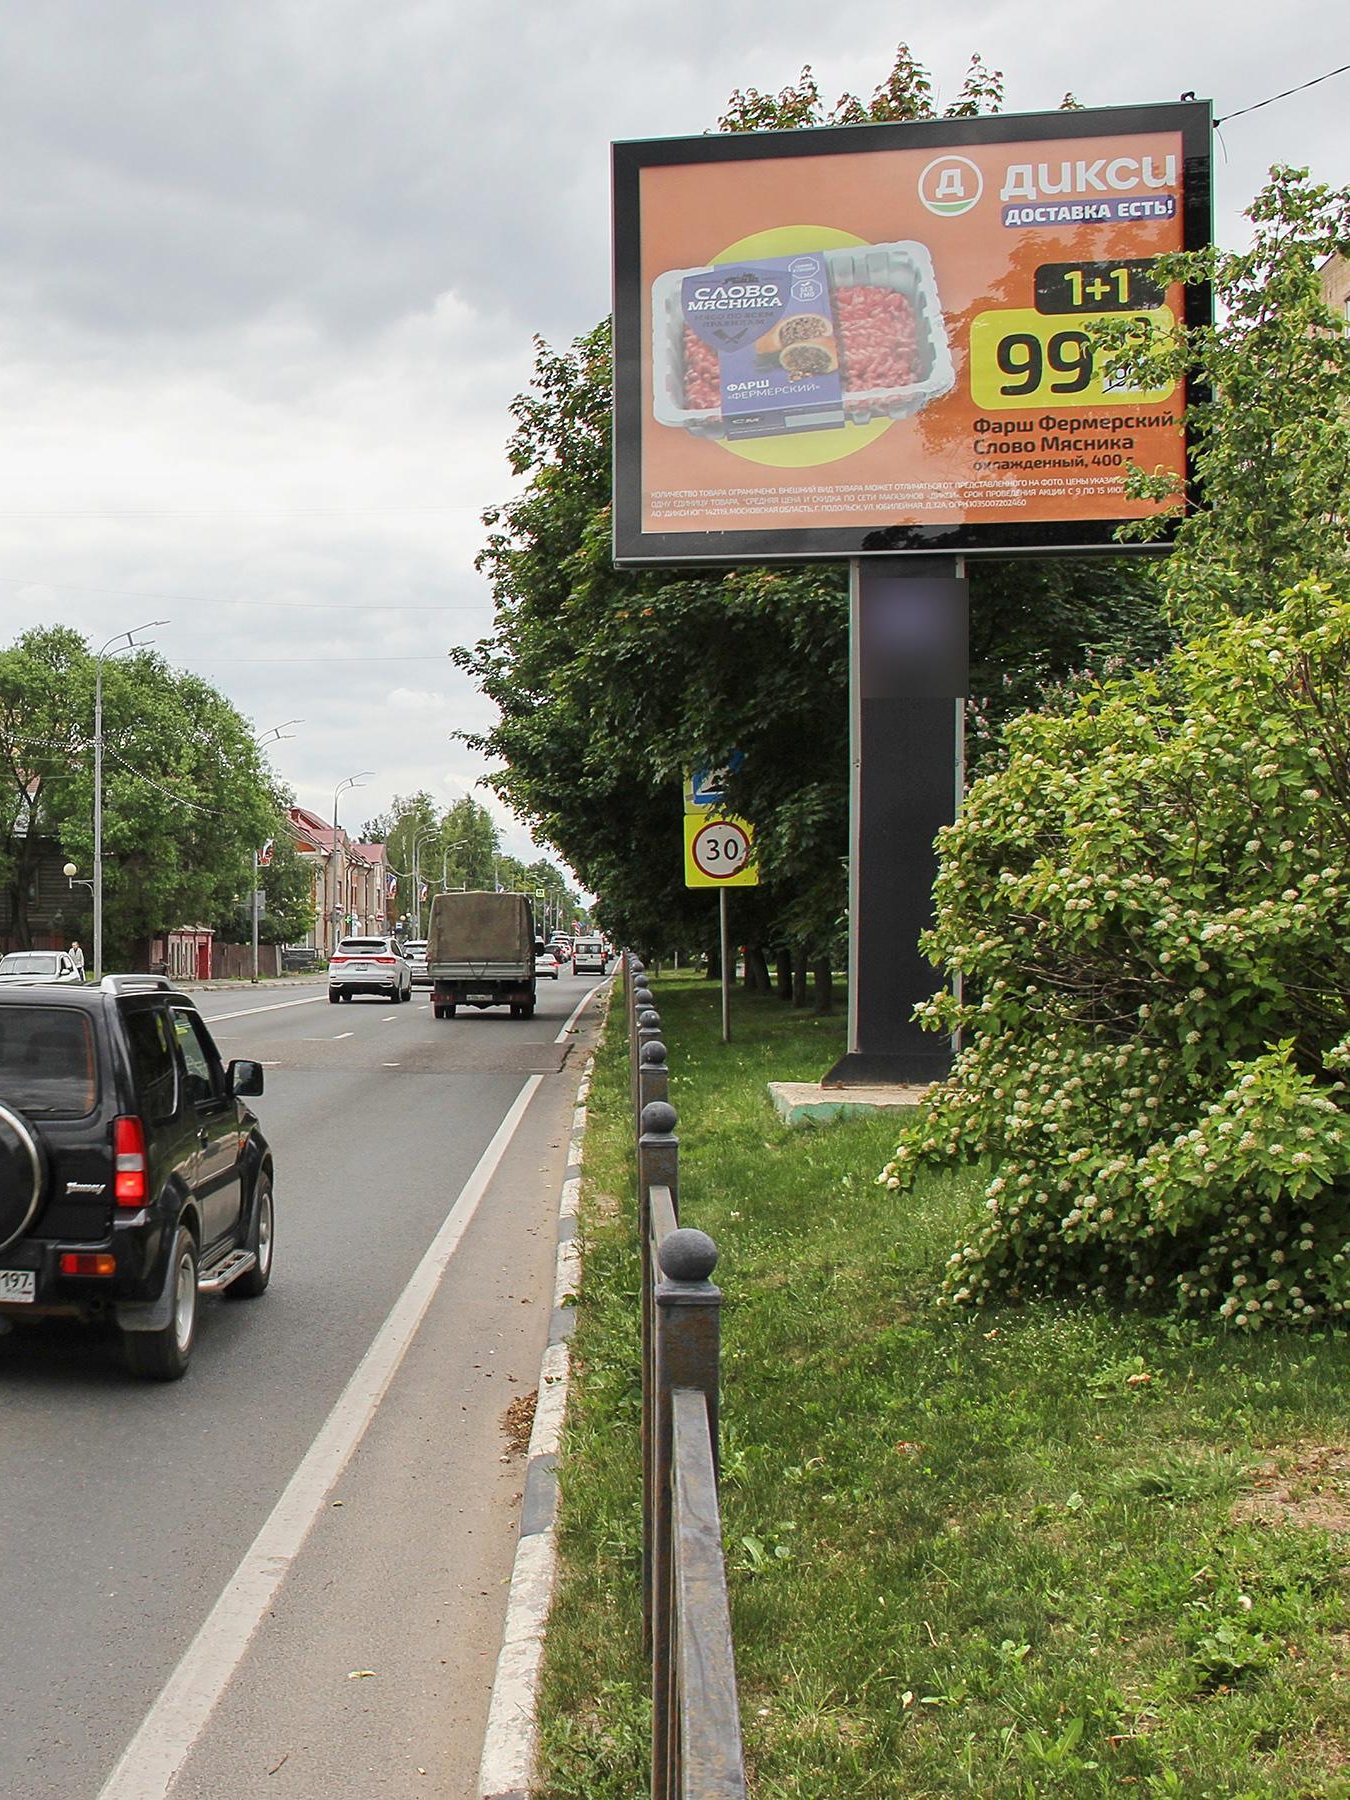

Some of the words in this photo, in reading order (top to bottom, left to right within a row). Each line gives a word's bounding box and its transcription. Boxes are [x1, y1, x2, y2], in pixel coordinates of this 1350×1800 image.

[1000, 154, 1176, 201] ДИКСИ
[1004, 203, 1112, 226] ДОСТАВКА
[1117, 199, 1174, 217] ЕСТЬ!
[694, 284, 779, 300] СЛОВО
[687, 297, 783, 311] МЯСНИКА
[996, 331, 1093, 396] 99
[726, 379, 770, 392] ФАРШ
[727, 382, 821, 400] «ФЕРМЕРСКИЙ»
[972, 417, 1034, 437] Фарш
[1038, 411, 1174, 435] Фермерский
[973, 438, 1036, 455] Слово
[1040, 436, 1134, 452] Мясника
[1091, 454, 1122, 467] 400
[1028, 479, 1040, 487] НА
[1065, 477, 1089, 487] ЦЕНЫ
[843, 494, 855, 502] ПО
[963, 490, 984, 498] СРОК
[1038, 487, 1066, 496] АКЦИИ
[1067, 487, 1074, 495] С
[1075, 487, 1081, 496] 9
[1082, 487, 1095, 495] ПО
[1097, 486, 1105, 495] 15
[706, 838, 739, 861] 30
[1, 1271, 30, 1289] 197
